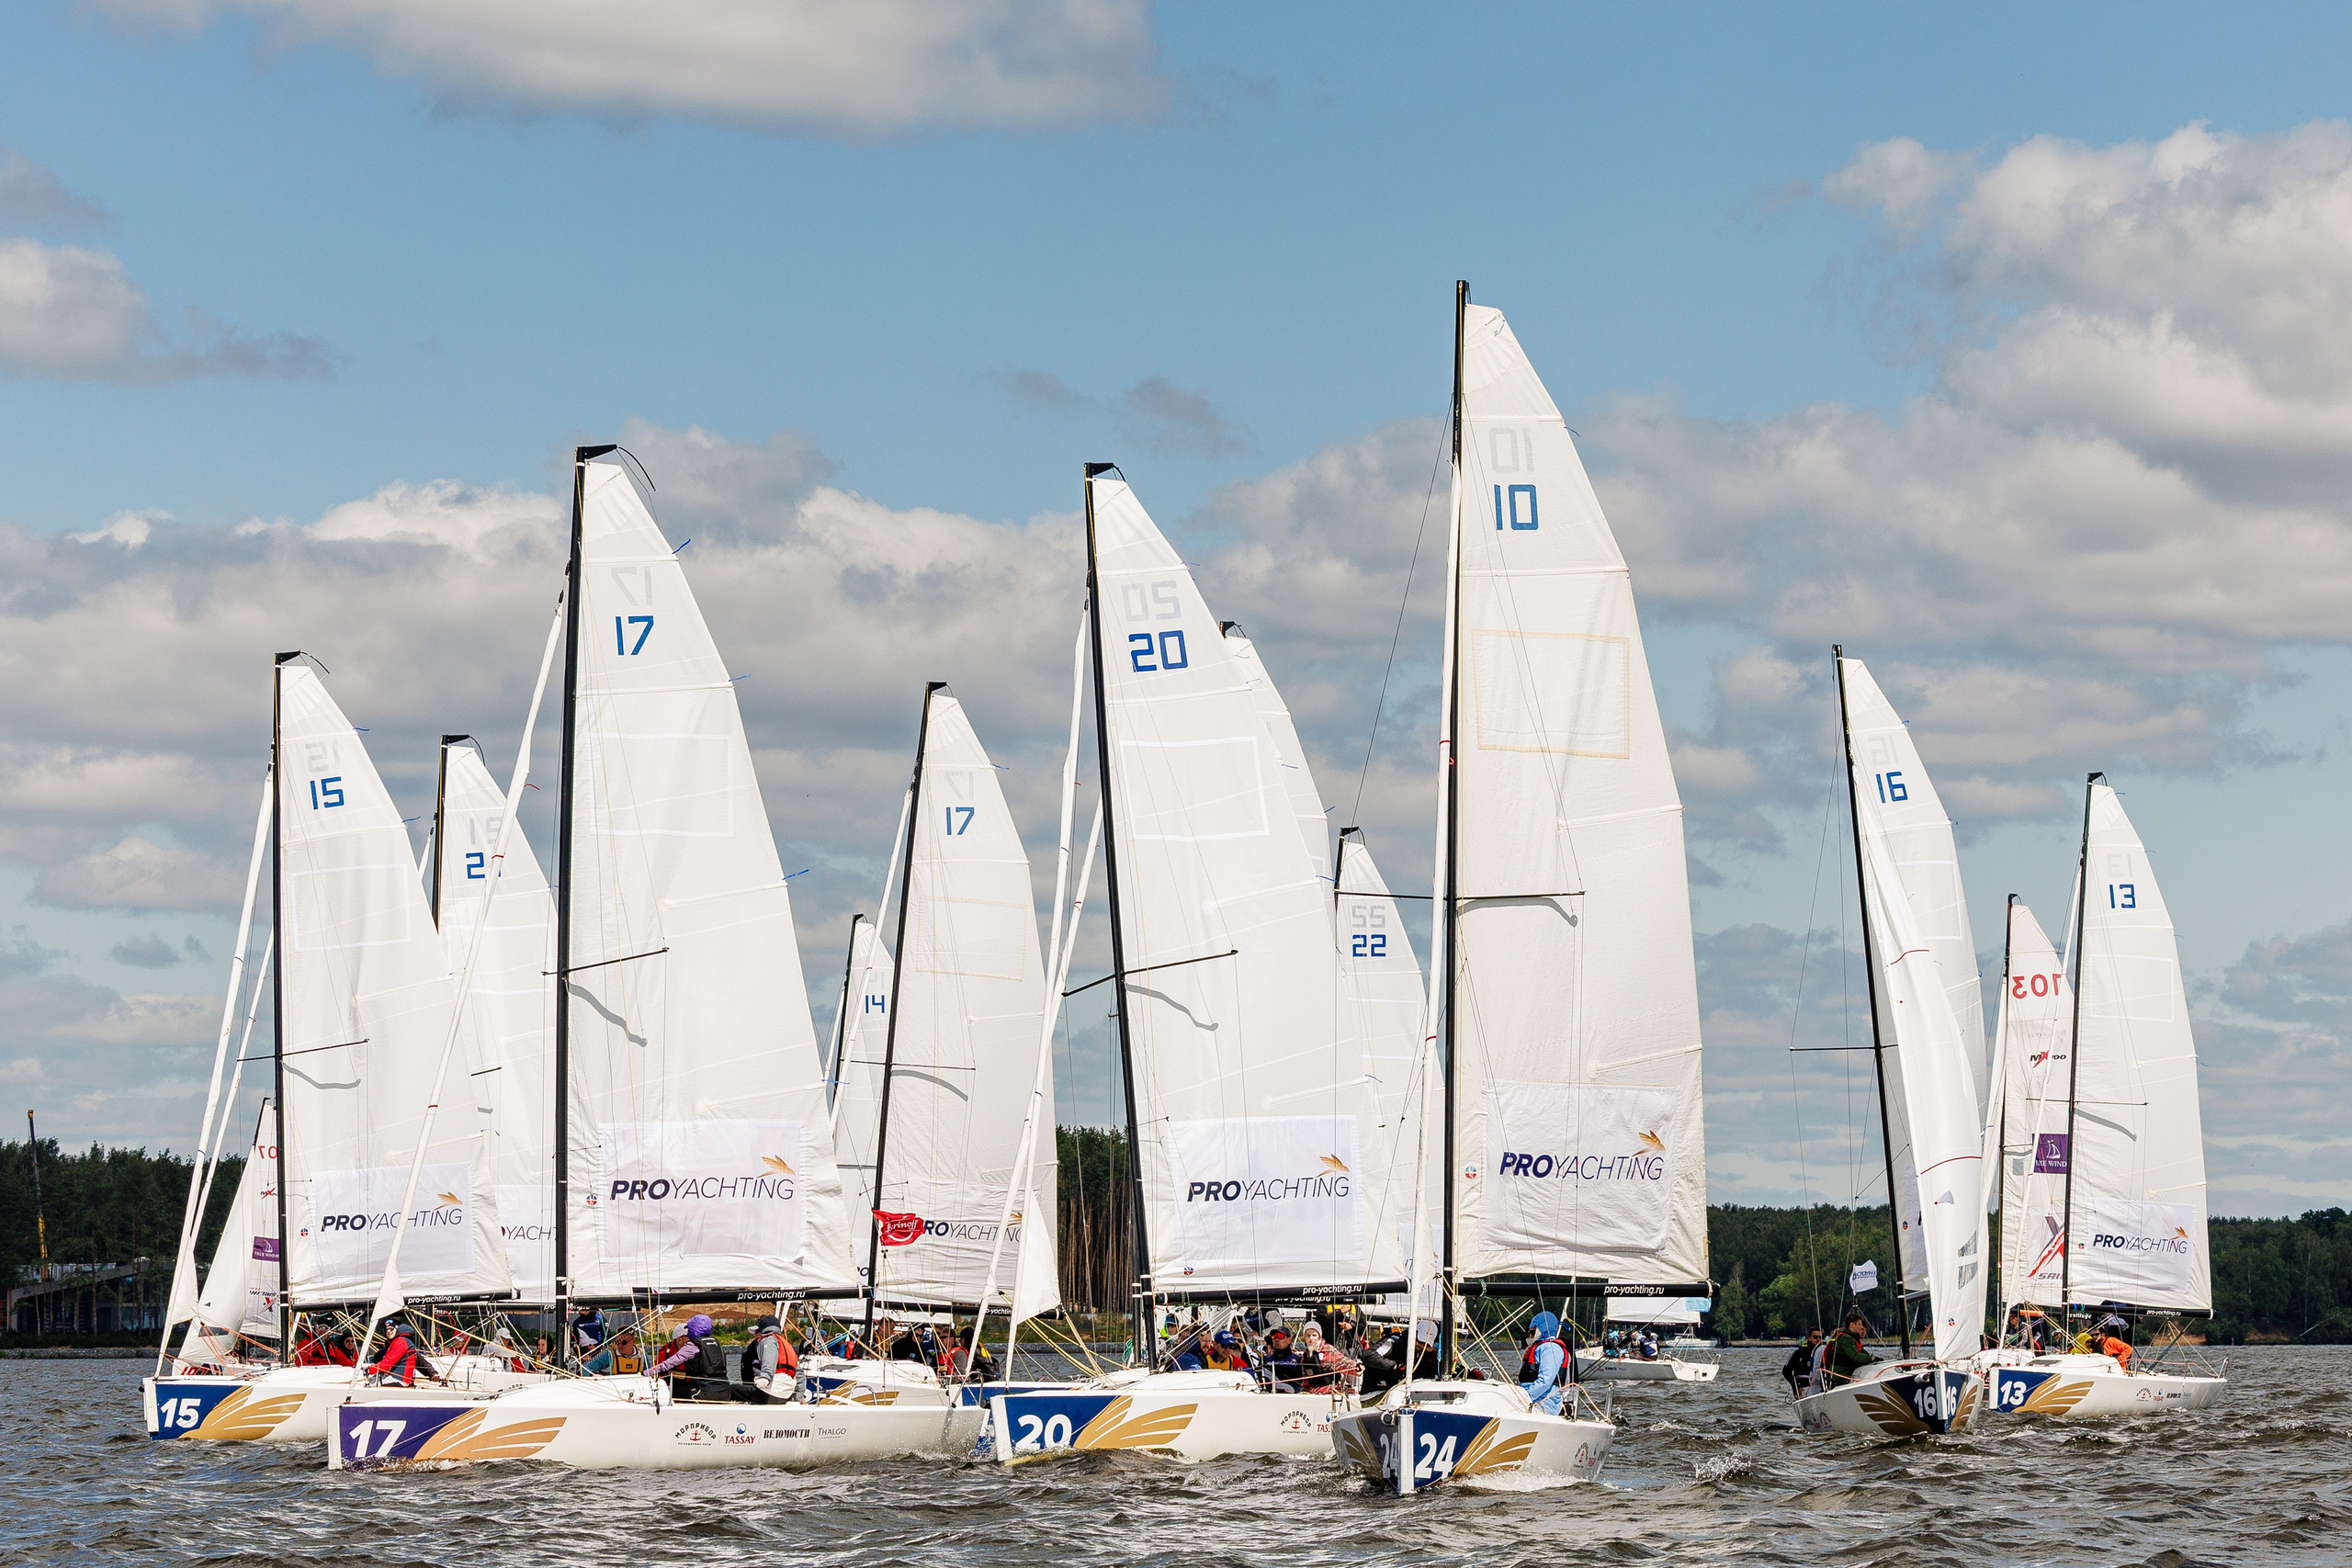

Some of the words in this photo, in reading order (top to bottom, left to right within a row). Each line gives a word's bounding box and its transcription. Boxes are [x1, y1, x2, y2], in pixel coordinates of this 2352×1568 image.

[1493, 483, 1539, 530] 10
[615, 615, 654, 656] 17
[1128, 630, 1188, 672] 20
[310, 776, 345, 810] 15
[1875, 771, 1908, 804] 16
[945, 807, 975, 835] 17
[466, 852, 502, 879] 2
[2109, 884, 2137, 909] 13
[1351, 933, 1386, 957] 22
[865, 995, 885, 1013] 14
[1498, 1151, 1664, 1181] PROYACHTING
[609, 1176, 795, 1201] PROYACHTING
[1187, 1175, 1351, 1202] PROYACHTING
[2093, 1234, 2188, 1254] PROYACHTING
[407, 1295, 461, 1304] pro-yachting.ru
[737, 1289, 806, 1301] pro-yachting.ru
[1303, 1285, 1363, 1295] pro-yachting.ru
[1603, 1284, 1664, 1296] pro-yachting.ru
[1914, 1386, 1937, 1418] 16
[1946, 1385, 1957, 1416] 16
[2000, 1381, 2027, 1405] 13
[160, 1398, 201, 1428] 15
[349, 1420, 407, 1459] 17
[724, 1435, 756, 1445] TASSAY
[763, 1428, 810, 1439] ВЕДОМОСТИ
[1015, 1414, 1073, 1450] 20
[1414, 1431, 1457, 1479] 24
